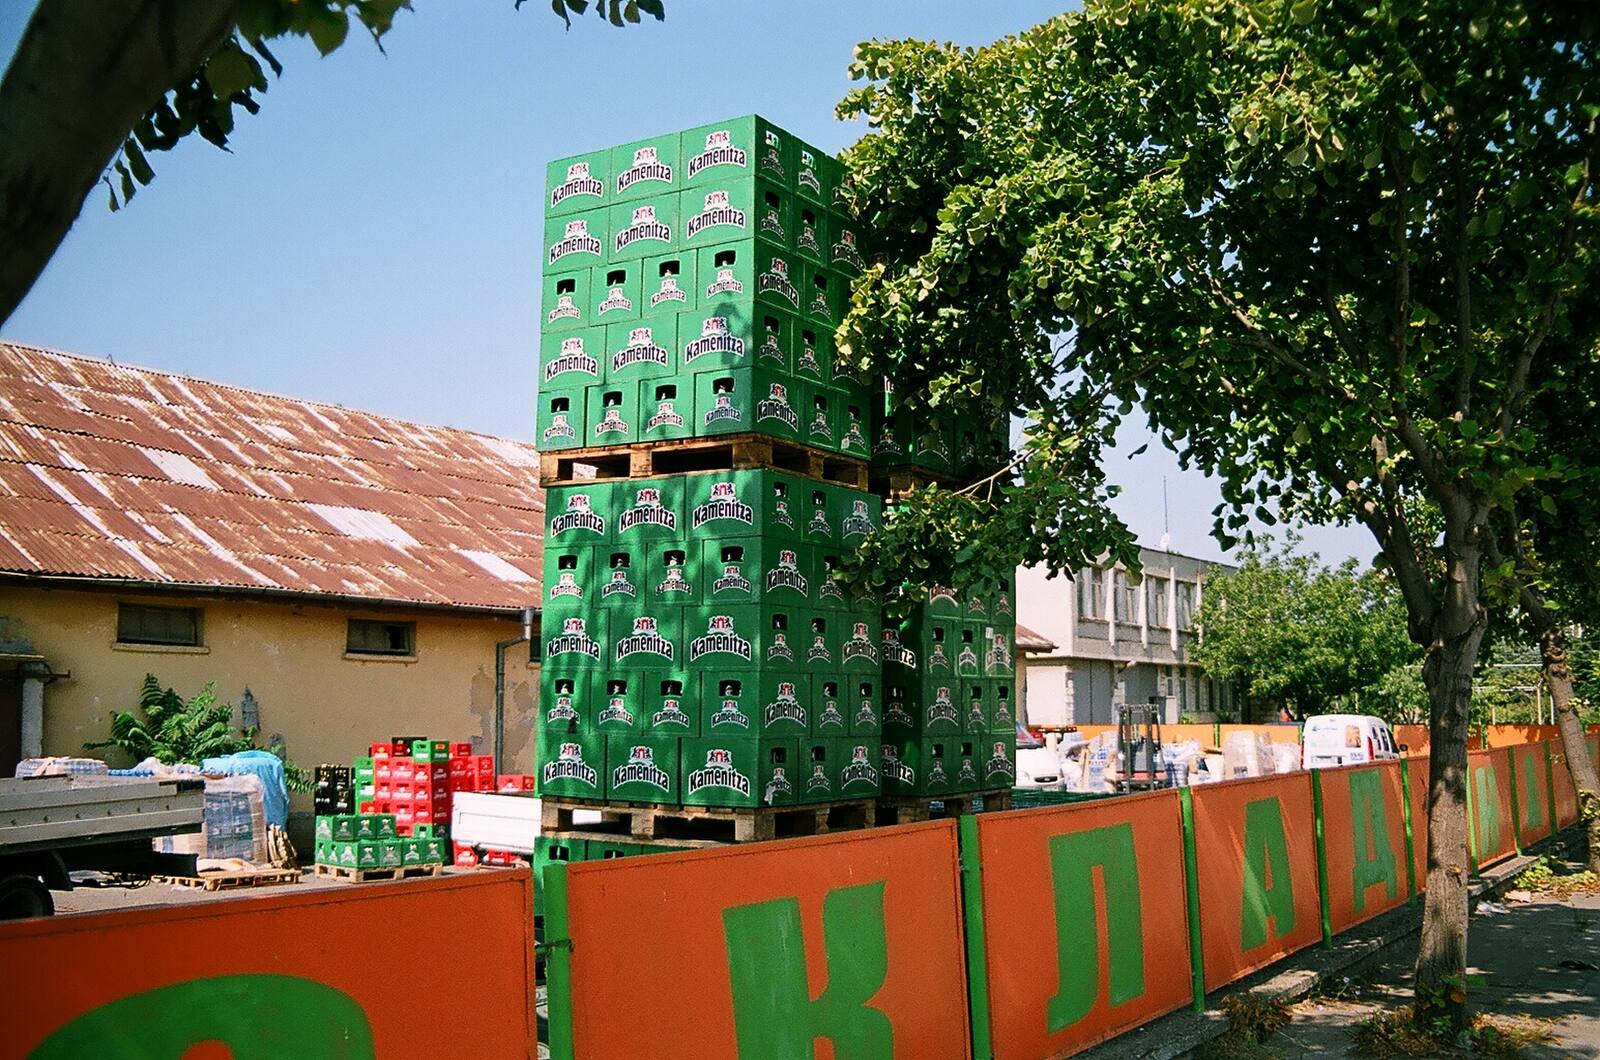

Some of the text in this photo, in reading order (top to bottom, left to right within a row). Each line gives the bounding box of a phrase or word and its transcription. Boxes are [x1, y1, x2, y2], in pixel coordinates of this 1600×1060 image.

[689, 146, 745, 176] Kamenitza
[618, 162, 671, 192] Kamenitza
[552, 177, 603, 206] Kamenitza
[688, 206, 745, 237] Kamenitza
[550, 236, 601, 263] Kamenitza
[616, 222, 670, 250] Kamenitza
[613, 343, 667, 371] Kamenitza
[686, 333, 744, 362] Kamenitza
[546, 352, 597, 379] Kamenitza
[552, 511, 604, 535] Kamenitza
[620, 506, 676, 532] Kamenitza
[693, 499, 753, 526] Kamenitza
[548, 632, 600, 659] Kamenitza
[617, 632, 673, 660] Kamenitza
[691, 632, 751, 660] Kamenitza
[883, 644, 916, 668] enitza
[545, 761, 597, 788] Kamenitza
[613, 763, 669, 791] Kamenitza
[689, 769, 750, 797] Kamenitza
[881, 761, 914, 785] enitza
